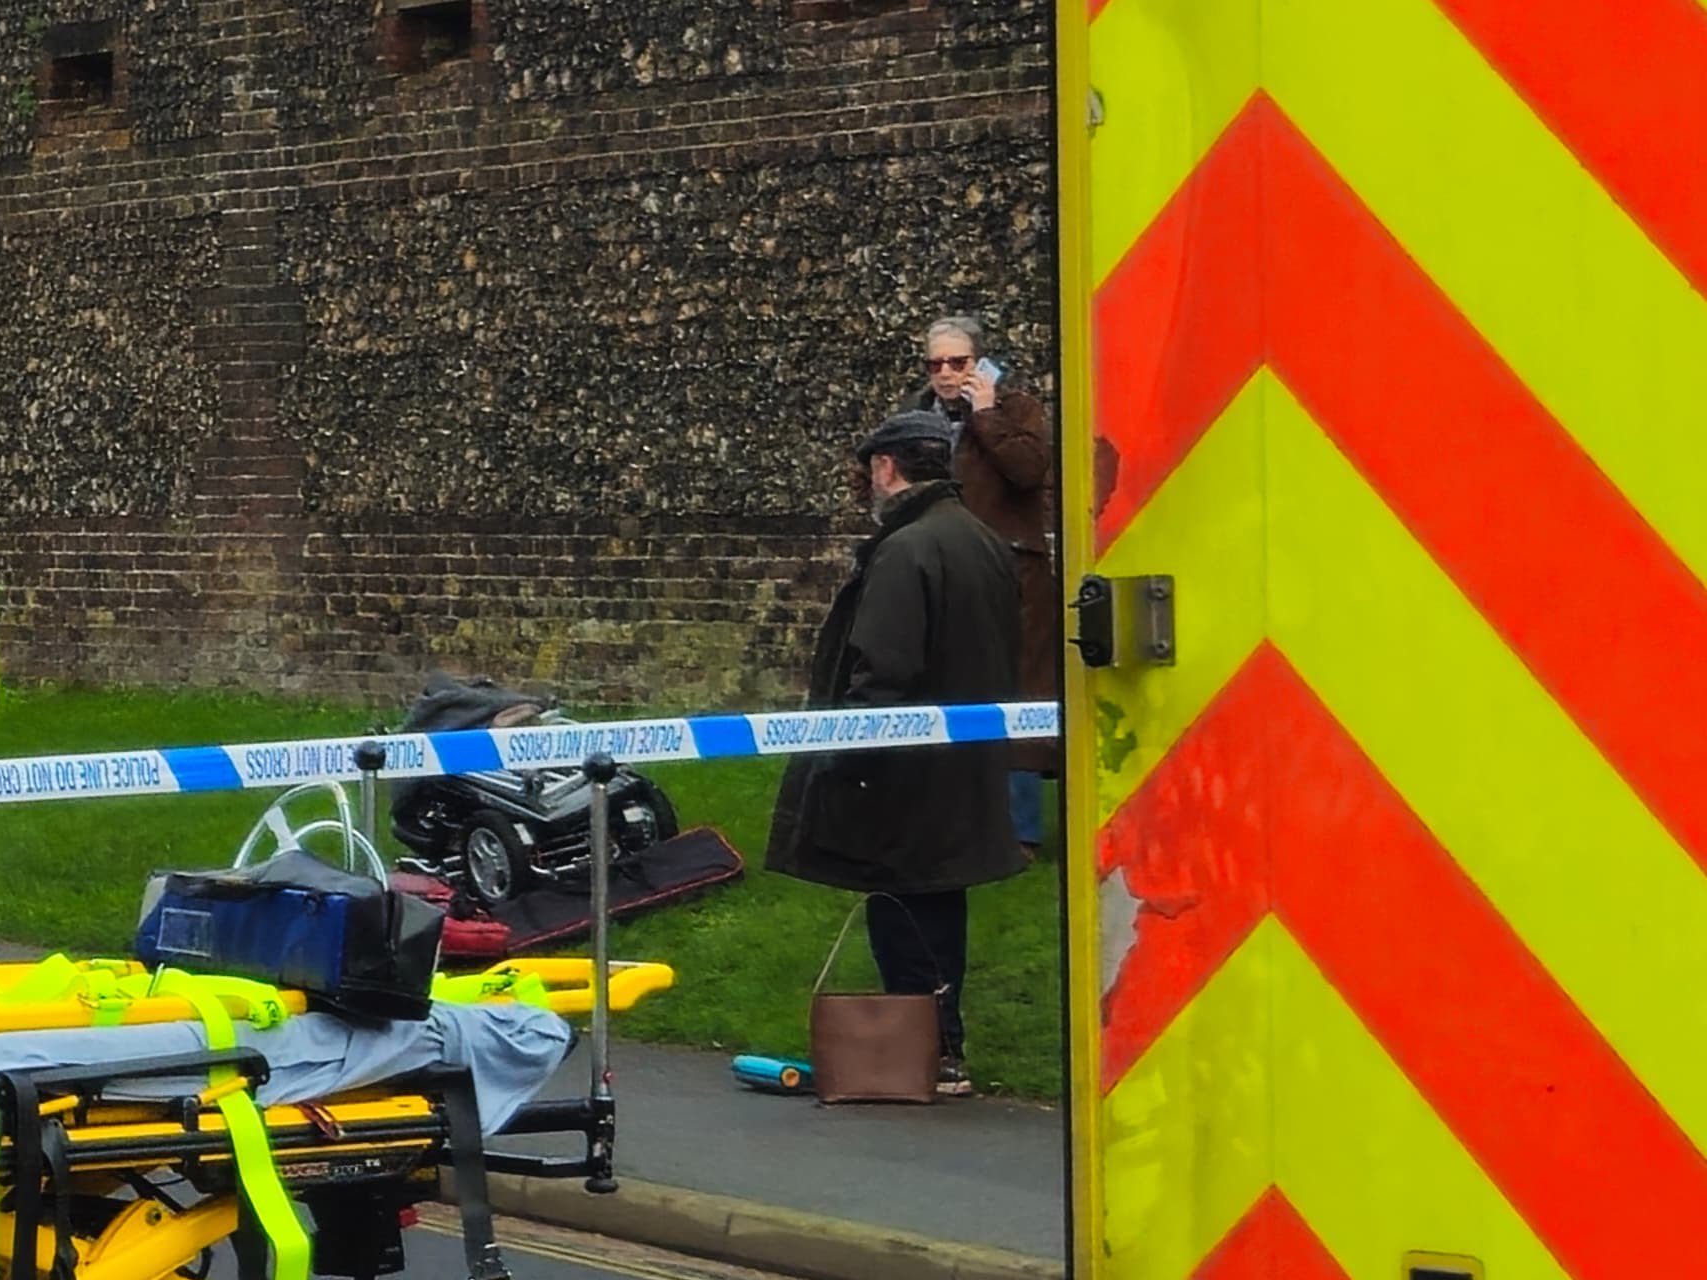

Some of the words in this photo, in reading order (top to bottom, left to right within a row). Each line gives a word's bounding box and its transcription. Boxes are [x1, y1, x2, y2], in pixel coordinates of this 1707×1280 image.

[637, 724, 683, 753] POLICE
[763, 718, 809, 746] CROSS
[807, 717, 837, 743] NOT
[837, 716, 857, 742] DO
[858, 714, 890, 741] LINE
[889, 713, 937, 738] POLICE
[378, 740, 424, 770] POLIC
[508, 733, 551, 763] CROSS
[555, 731, 582, 761] NOT
[607, 727, 637, 757] LINE
[112, 756, 161, 787] POLICE
[246, 748, 290, 779] CROSS
[295, 746, 321, 777] NOT
[325, 744, 344, 774] DO
[25, 763, 54, 793] NOT
[56, 761, 77, 791] DO
[79, 760, 110, 790] LINE
